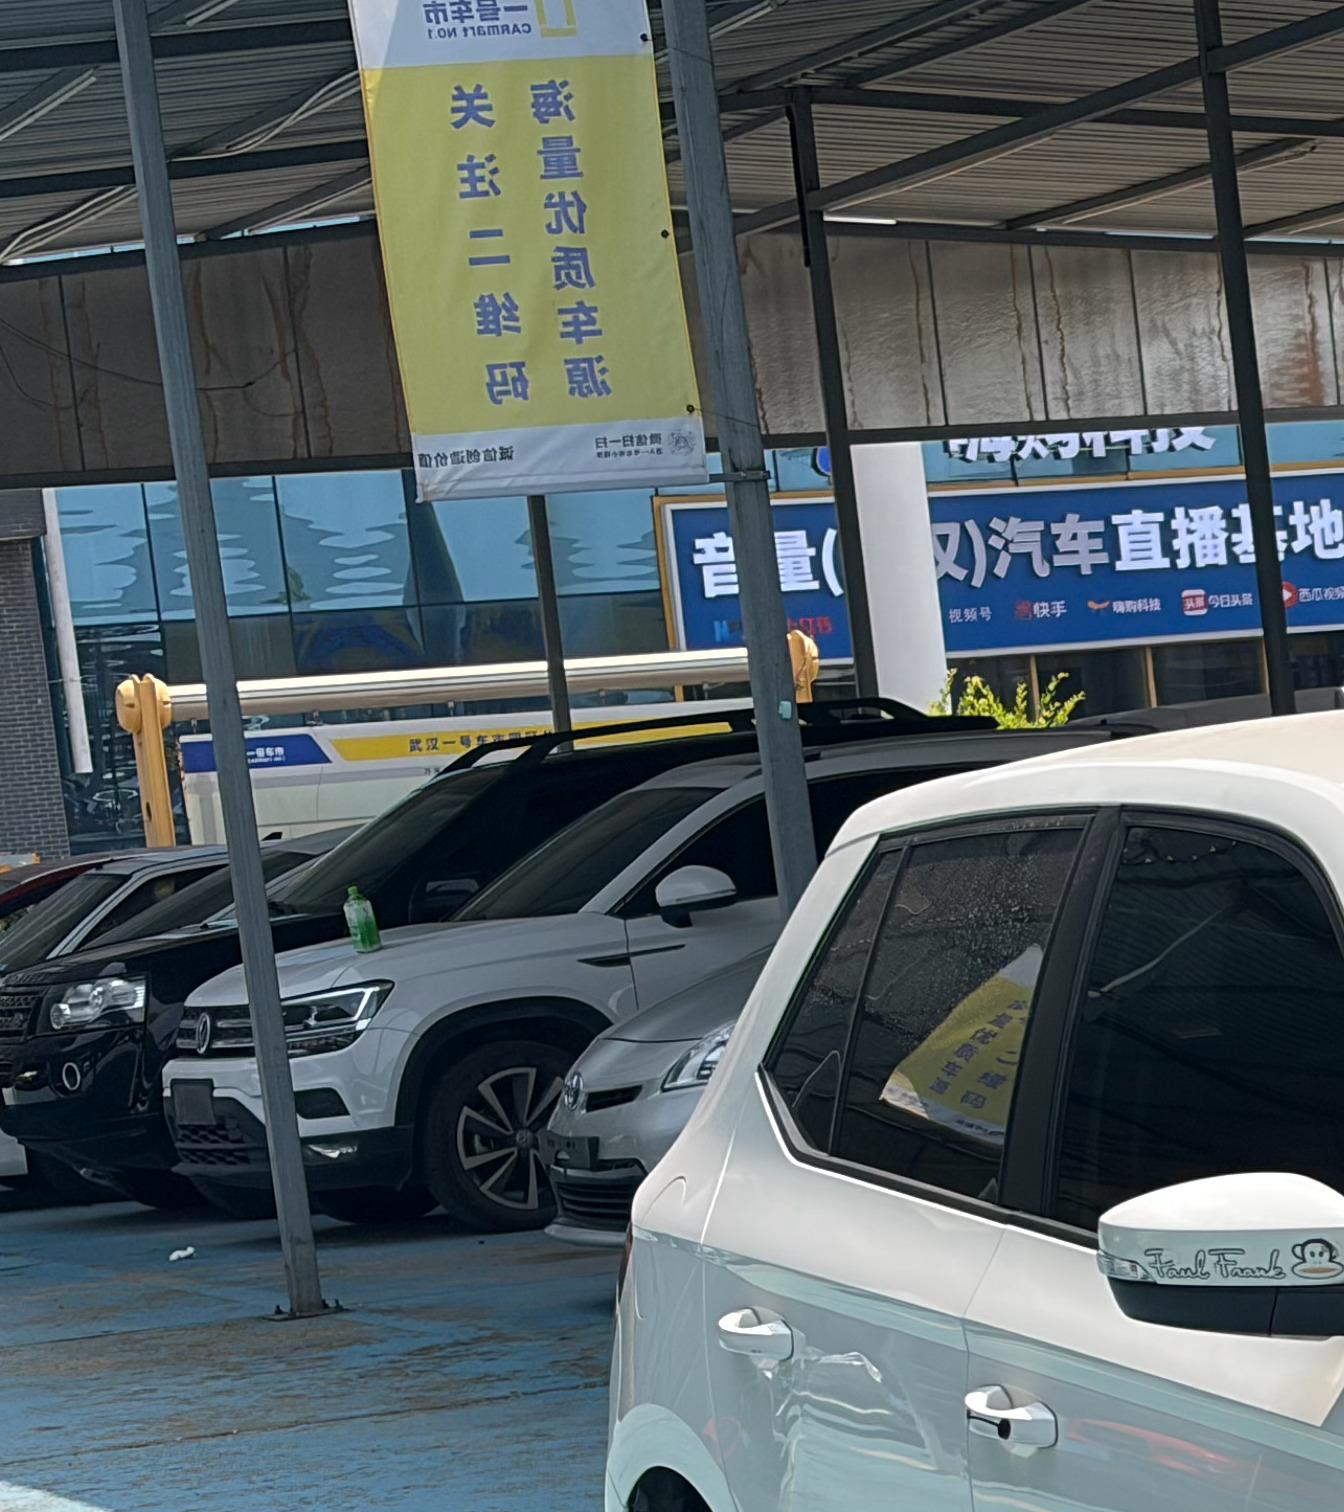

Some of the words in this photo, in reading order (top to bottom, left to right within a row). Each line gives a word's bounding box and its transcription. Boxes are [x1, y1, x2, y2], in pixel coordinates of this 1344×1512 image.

[1033, 600, 1068, 619] 快手
[1208, 593, 1254, 609] 今日头条
[949, 606, 992, 624] 视频号
[1208, 1247, 1287, 1279] Frank
